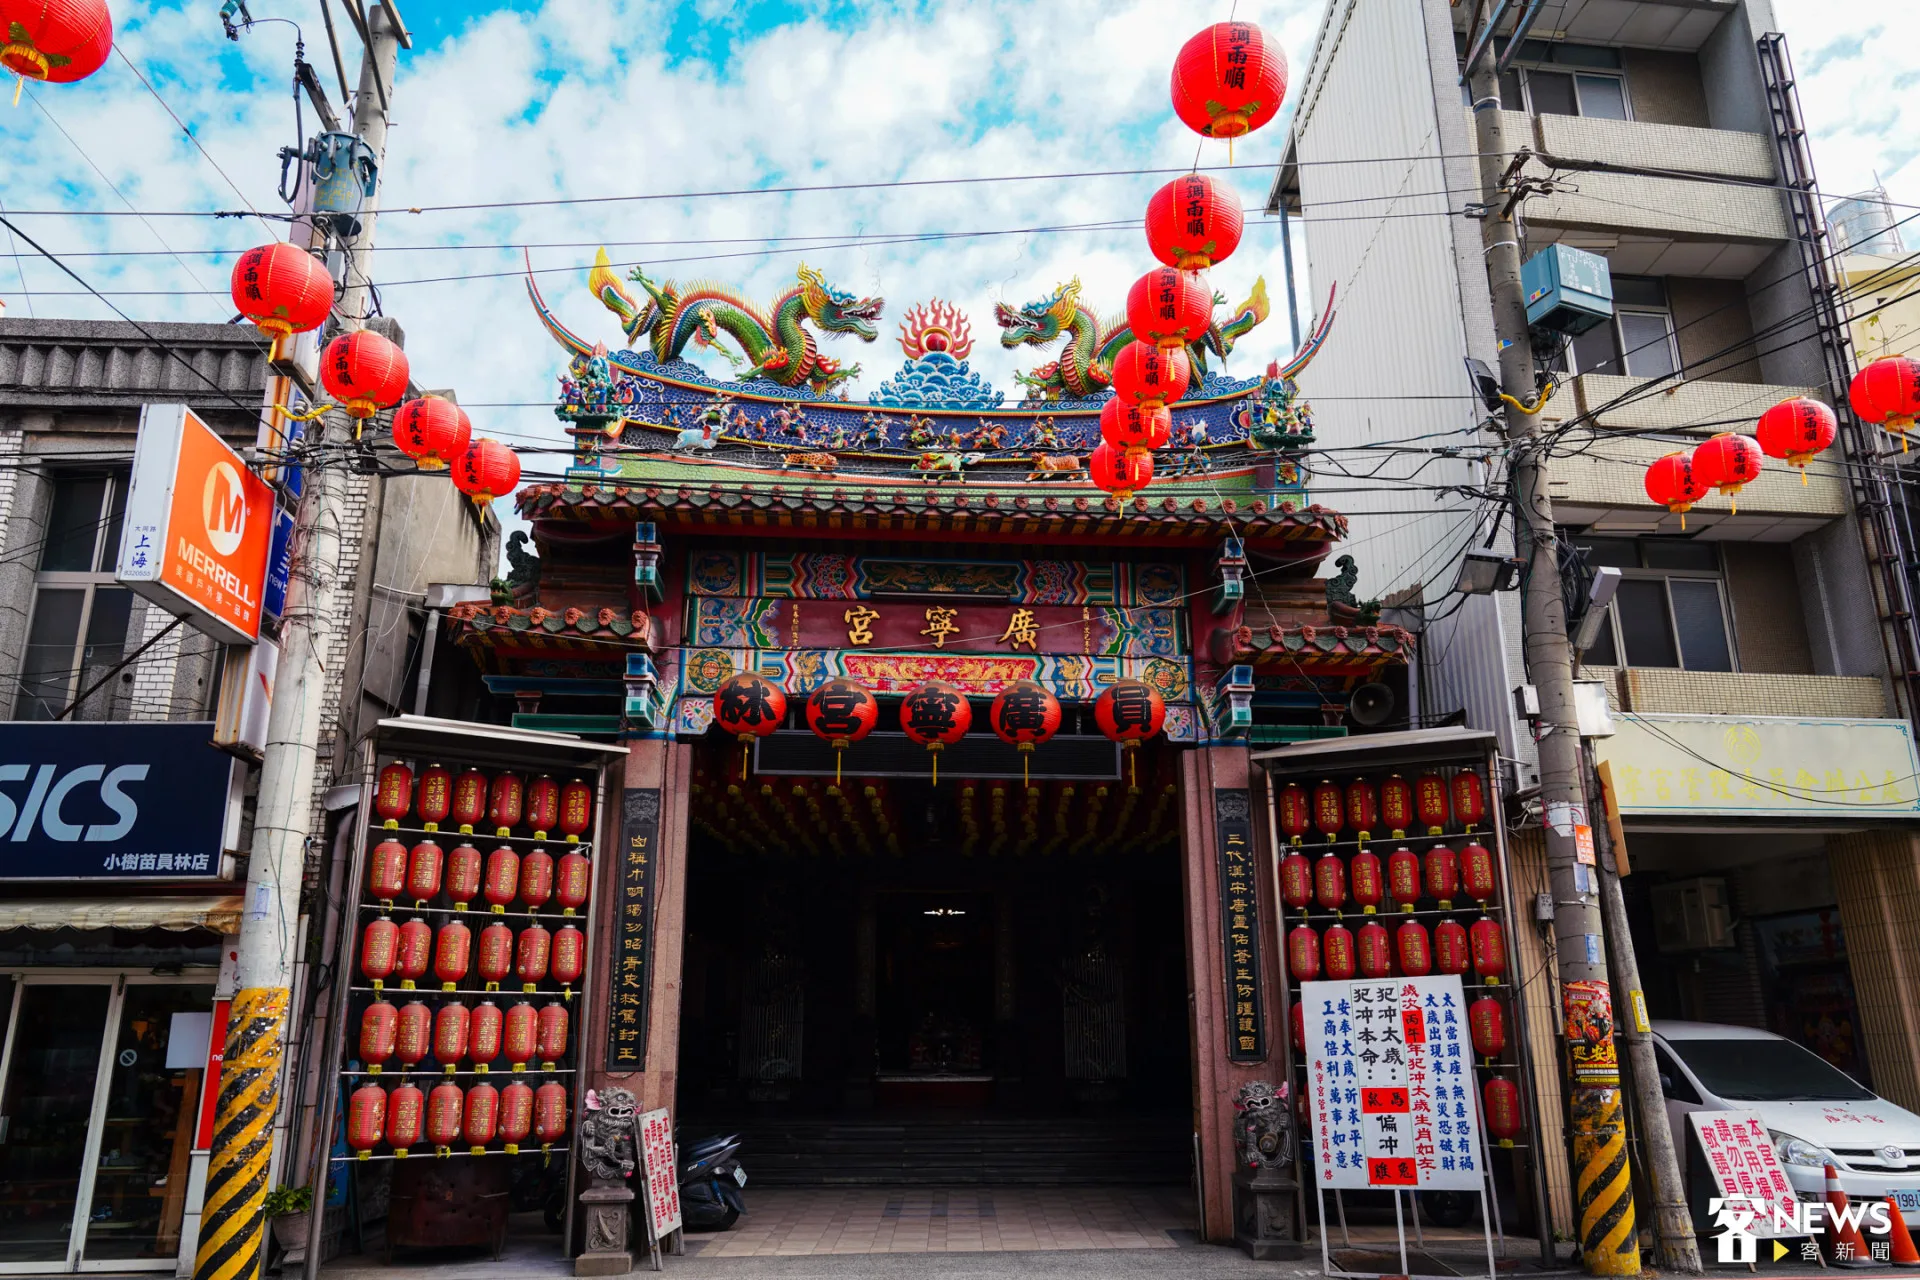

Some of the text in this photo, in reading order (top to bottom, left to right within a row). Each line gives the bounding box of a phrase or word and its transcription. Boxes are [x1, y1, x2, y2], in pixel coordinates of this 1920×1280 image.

[132, 534, 151, 568] 上海
[177, 536, 252, 606] MERRELL
[843, 605, 1040, 651] 廣寧宮
[719, 679, 776, 725] 林
[812, 684, 867, 734] 宮
[906, 687, 960, 738] 寧
[1001, 686, 1047, 737] 廣
[1111, 685, 1152, 733] 員
[104, 853, 210, 871] 小樹苗員林店
[1714, 1118, 1766, 1222] 請勿停
